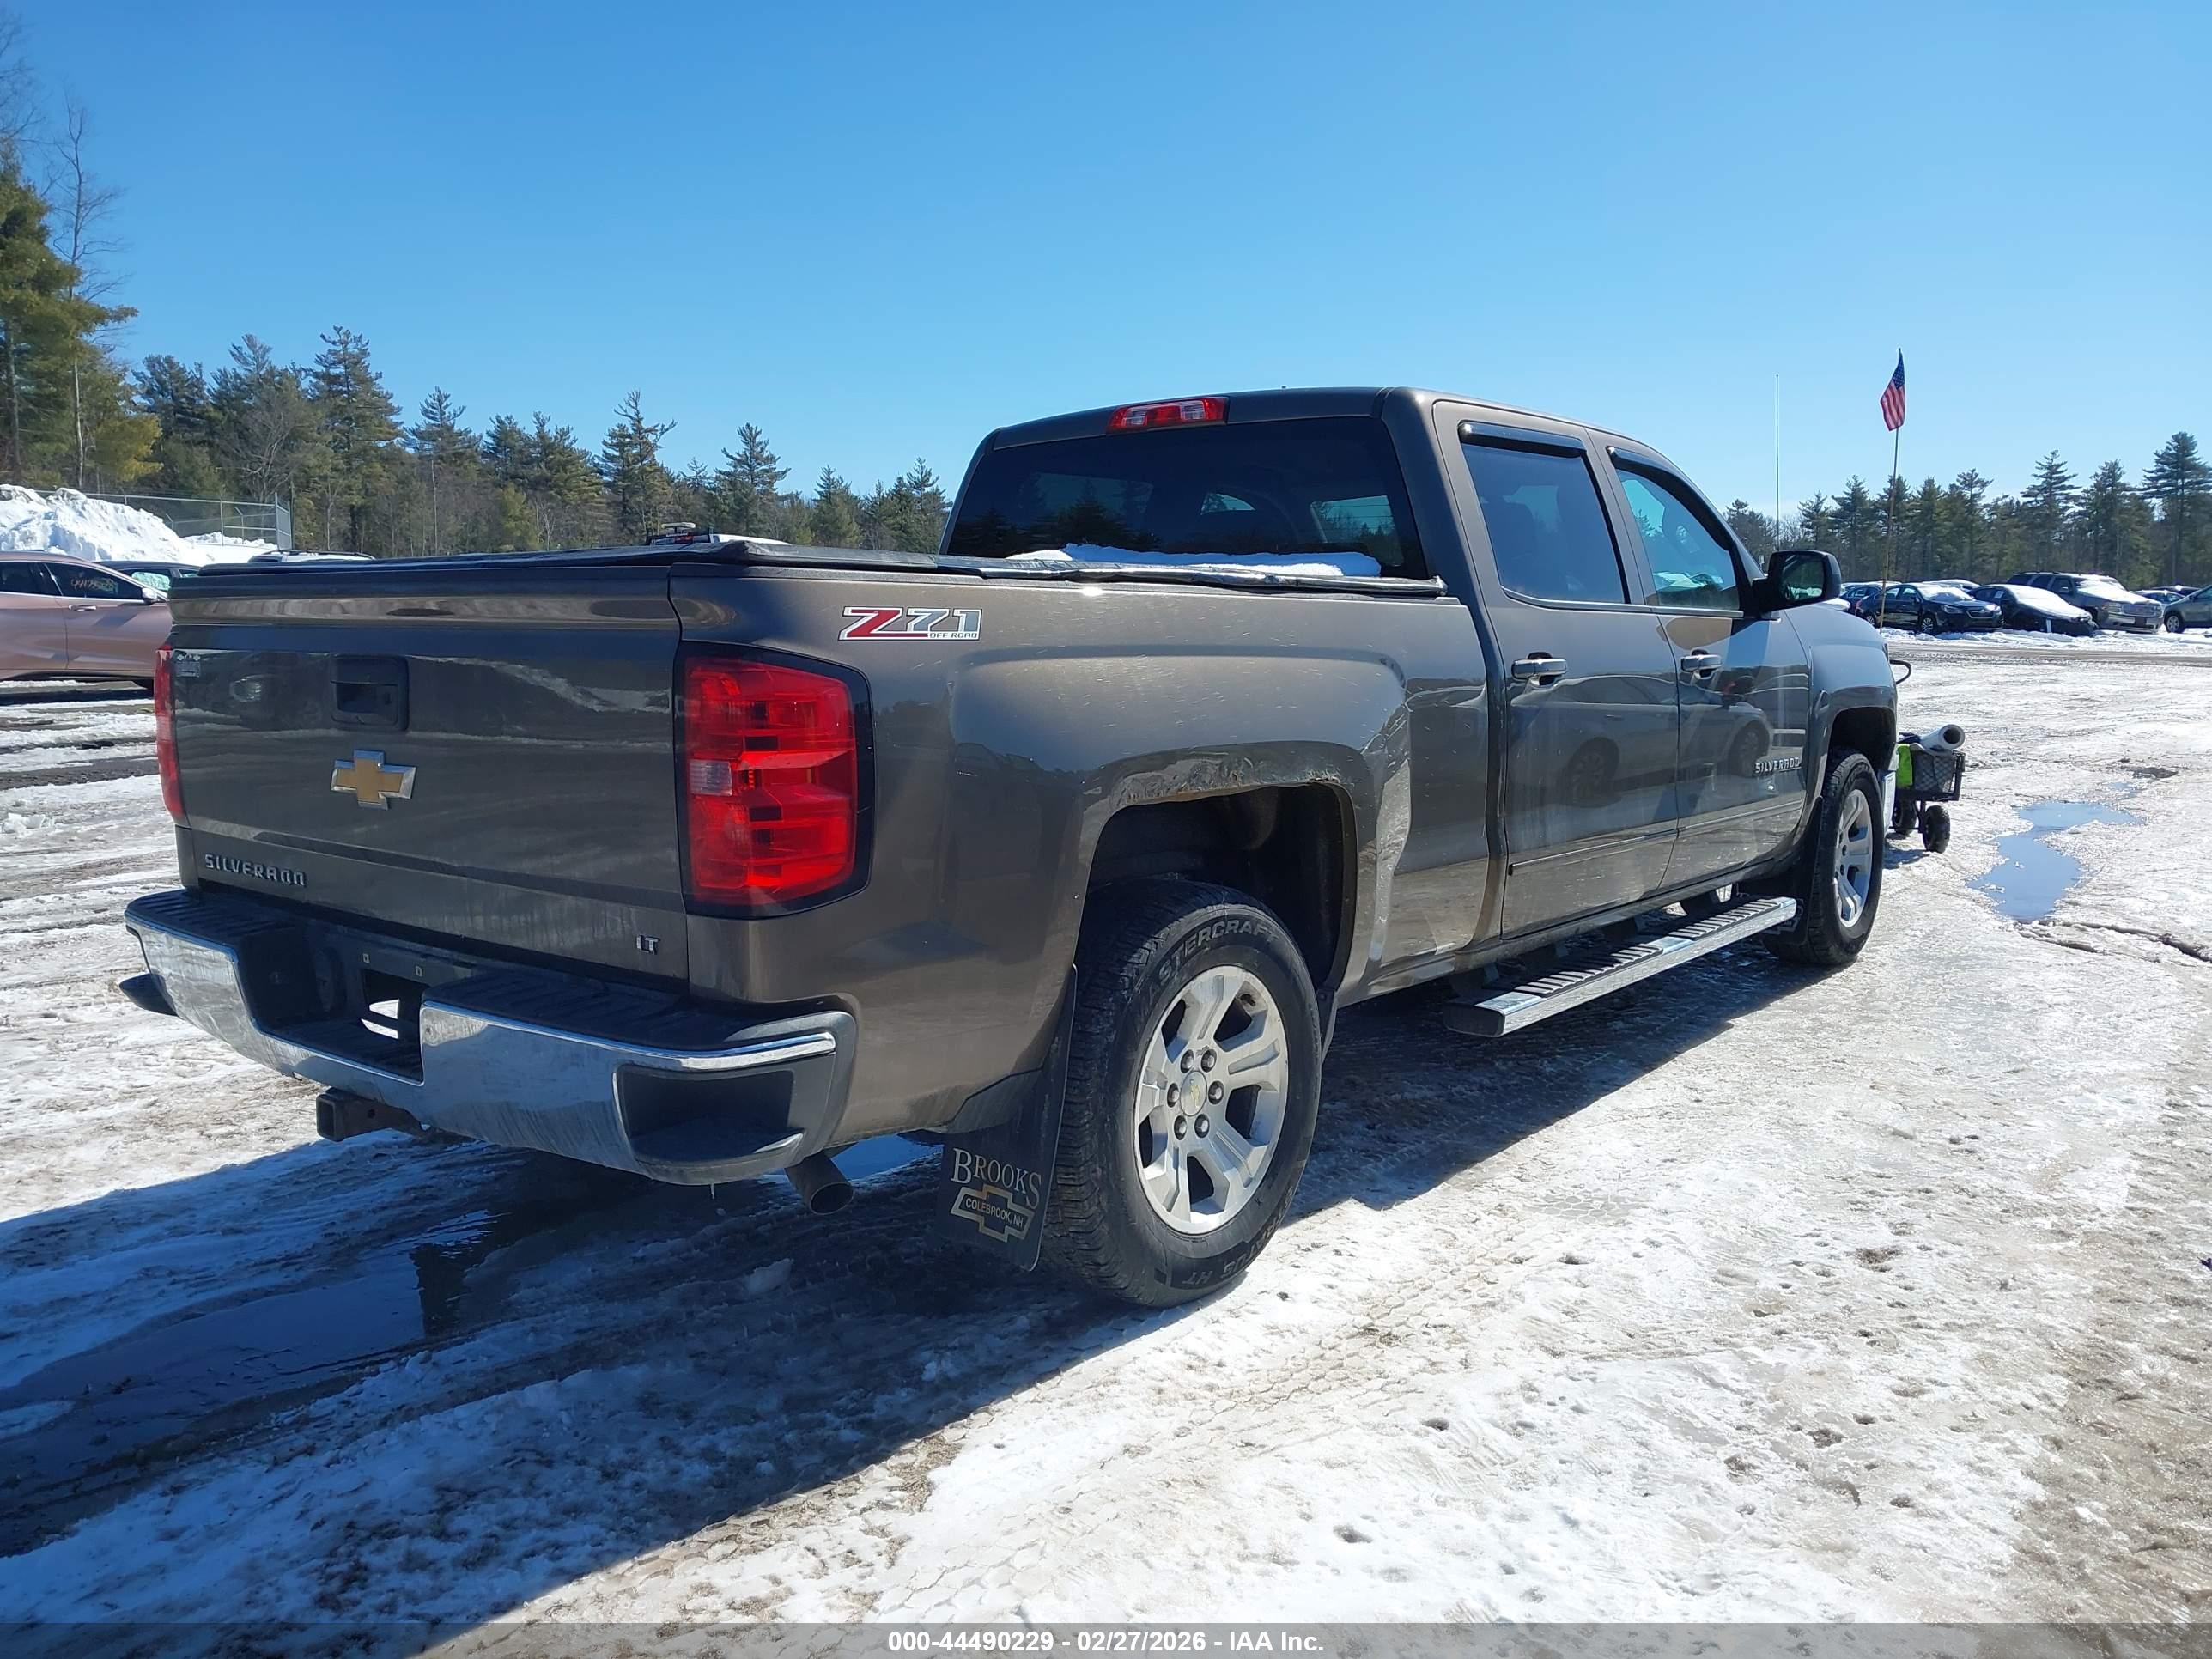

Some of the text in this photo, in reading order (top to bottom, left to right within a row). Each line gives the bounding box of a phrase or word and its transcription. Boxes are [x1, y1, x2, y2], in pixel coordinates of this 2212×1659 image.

[838, 606, 982, 641] Z71
[1755, 757, 1800, 773] SILVERADO
[204, 854, 305, 886] SILVERADO
[636, 935, 659, 955] LT
[951, 1147, 1042, 1209] BROOKS
[965, 1198, 1024, 1228] COLEBROOK, NH
